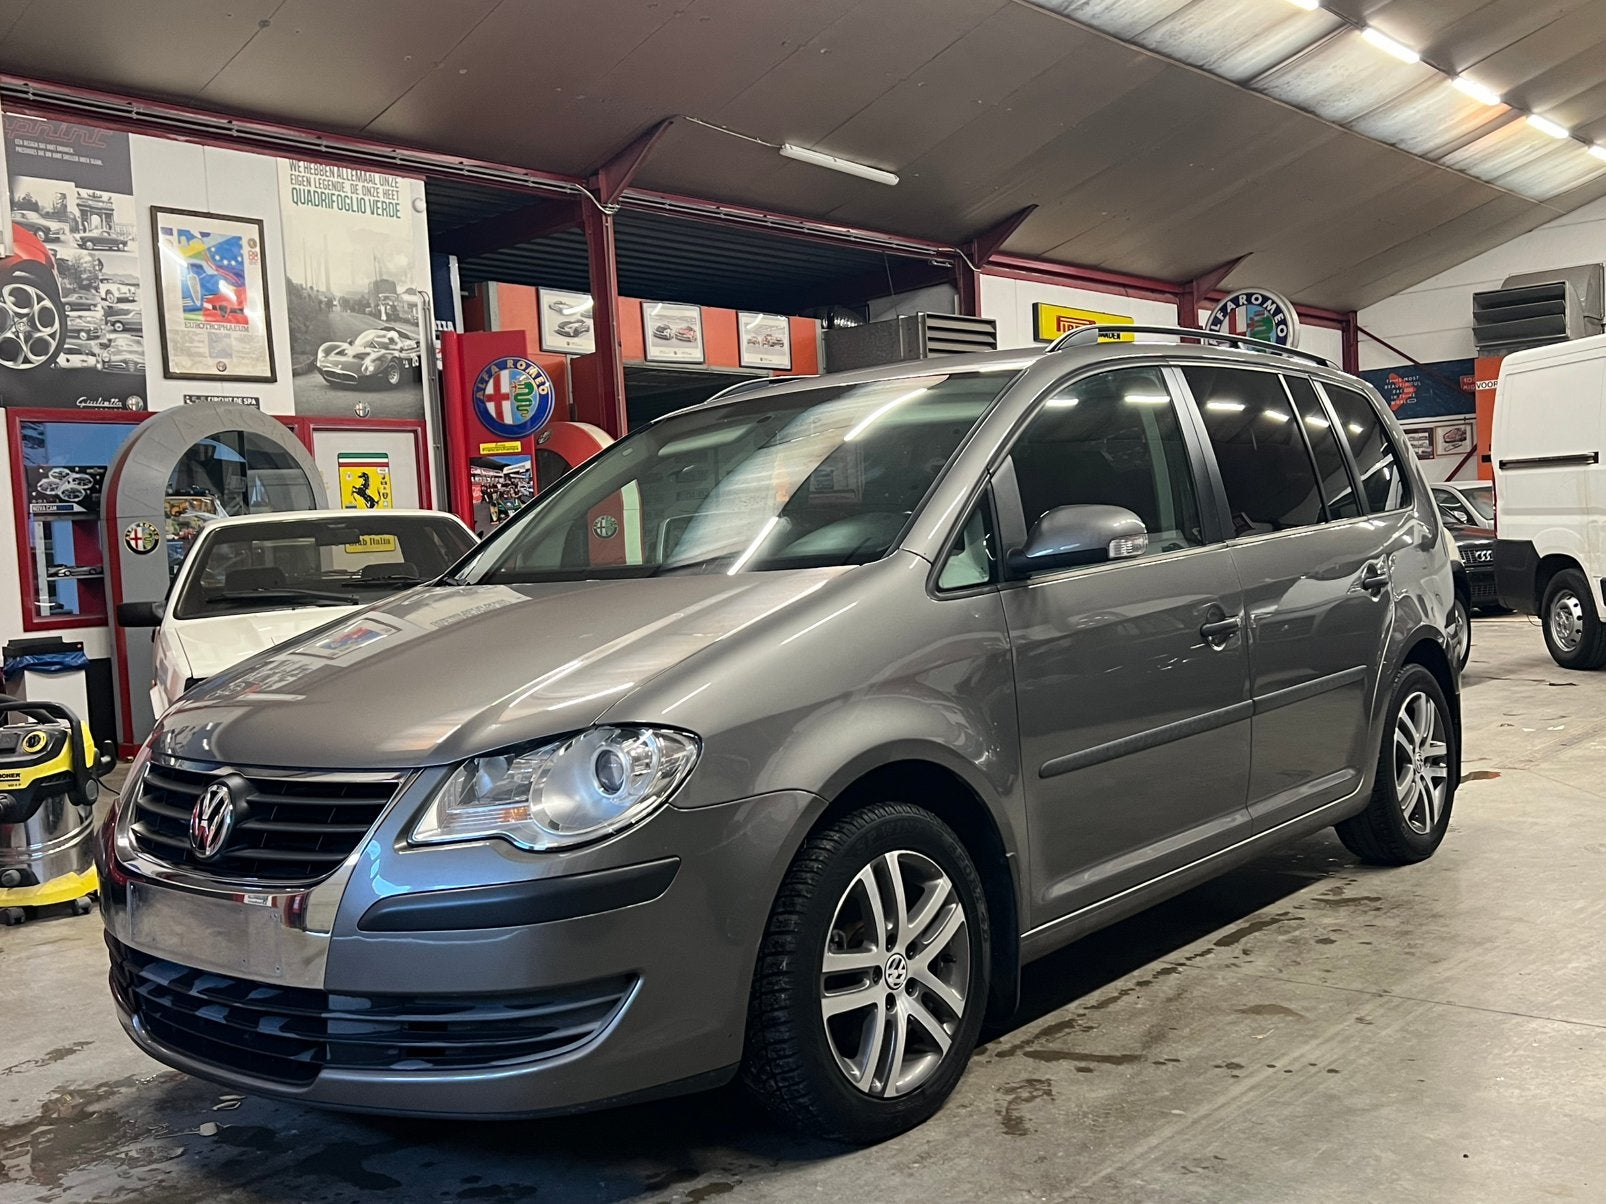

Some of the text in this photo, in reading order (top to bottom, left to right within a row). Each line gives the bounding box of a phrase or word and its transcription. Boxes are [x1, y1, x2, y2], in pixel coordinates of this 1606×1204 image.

[289, 160, 399, 188] WE HEBBEN ALLEMAAL ONZE
[290, 174, 399, 201] EIGEN LEGENDE. DE ONZE HEET
[291, 187, 401, 219] QUADRIFOGLIO VERDE
[1239, 293, 1287, 337] ROMEO
[476, 359, 549, 400] ALFA ROMEO
[76, 396, 123, 408] Giulietta
[369, 537, 391, 546] Italia
